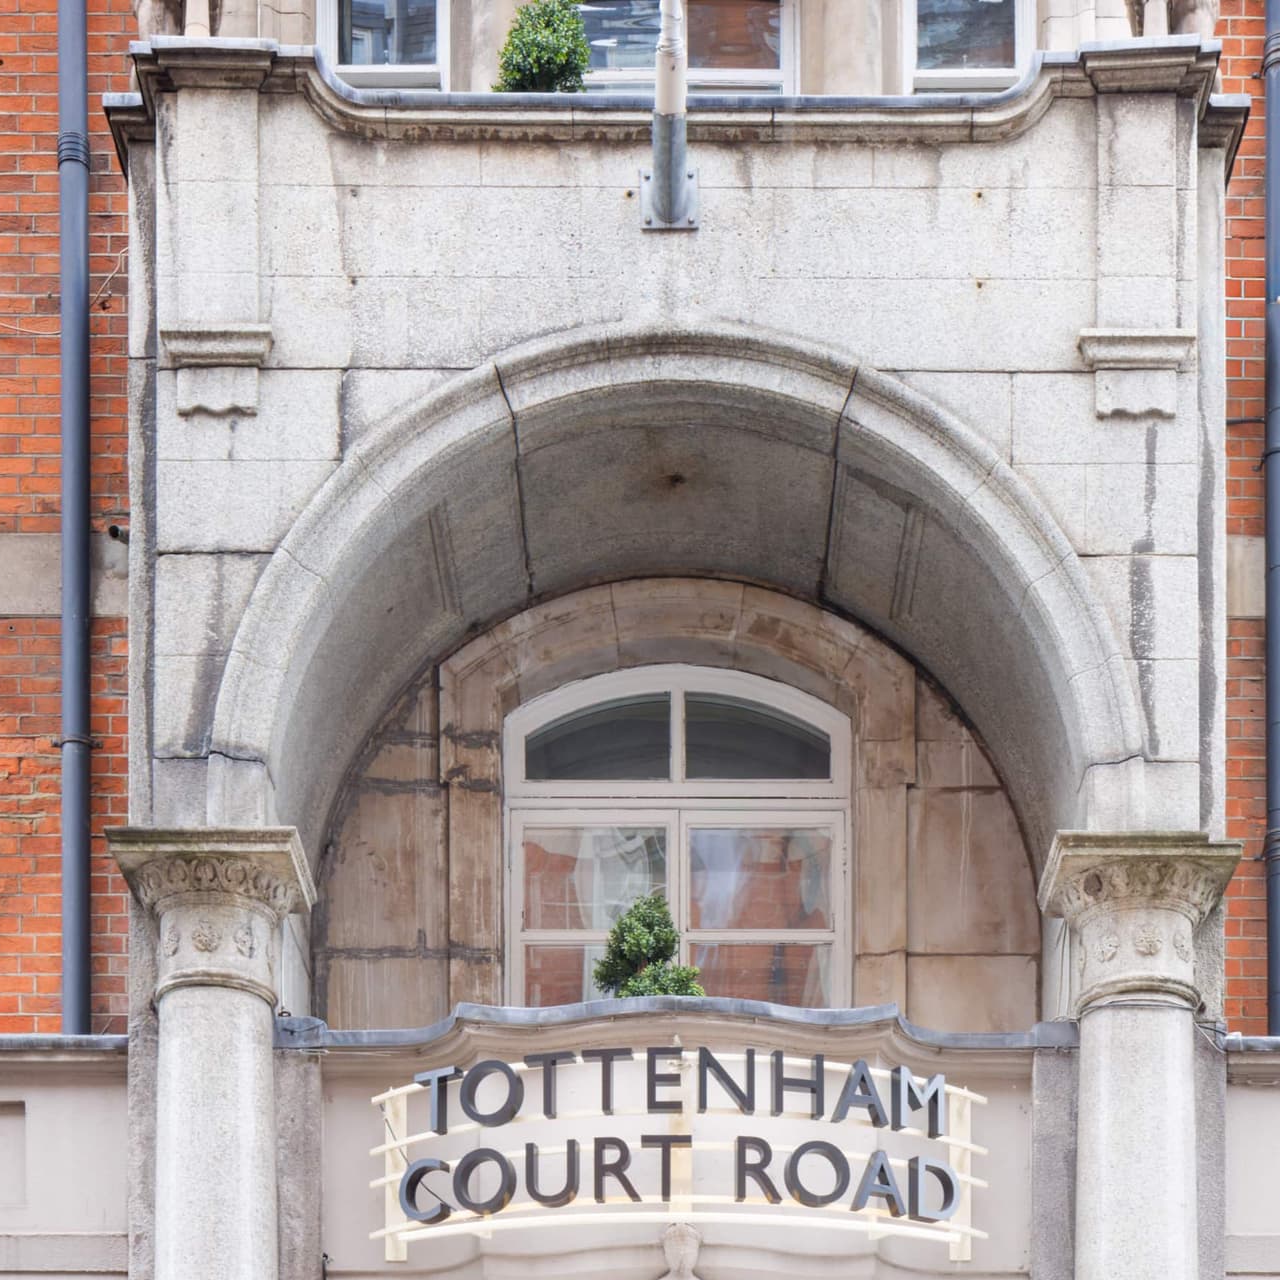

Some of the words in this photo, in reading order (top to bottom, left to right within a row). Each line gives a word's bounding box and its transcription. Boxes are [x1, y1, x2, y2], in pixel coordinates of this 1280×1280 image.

[414, 1047, 945, 1139] TOTTENHAM
[399, 1134, 693, 1224] COURT
[734, 1136, 960, 1223] ROAD
